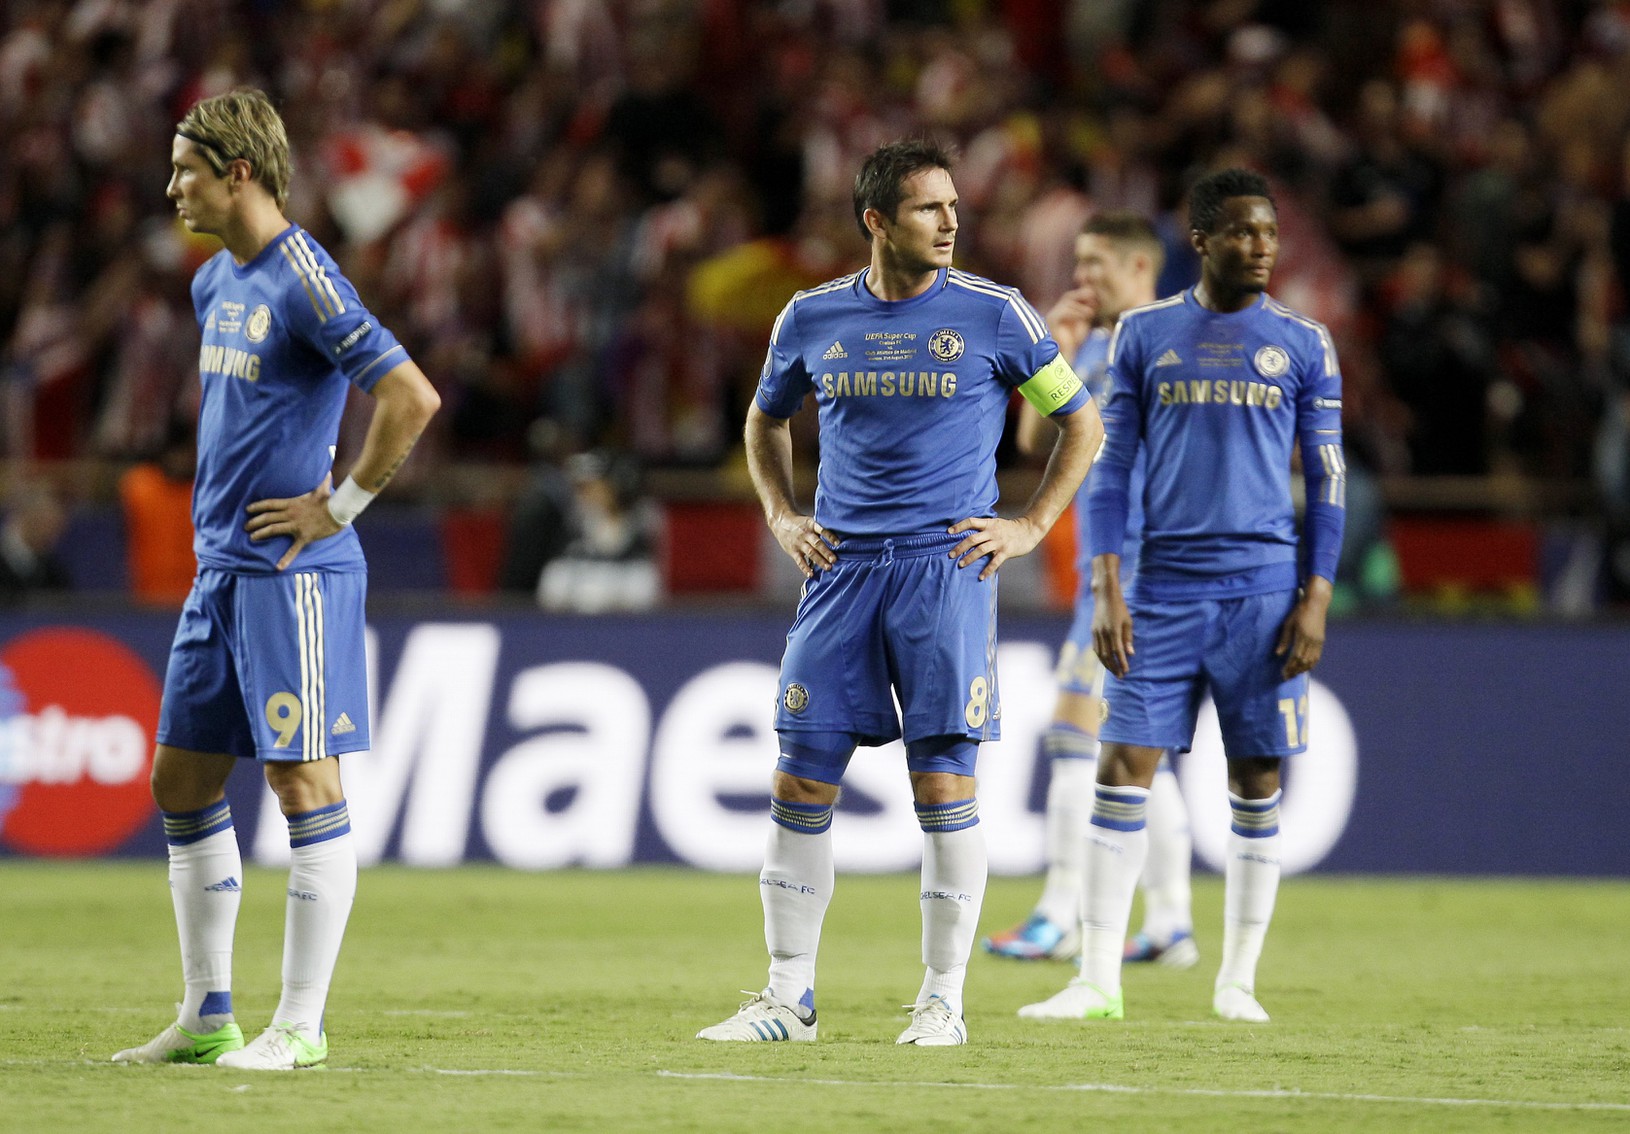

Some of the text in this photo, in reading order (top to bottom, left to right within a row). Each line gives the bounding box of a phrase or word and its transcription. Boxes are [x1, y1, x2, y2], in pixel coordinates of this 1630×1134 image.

[865, 333, 917, 341] UEFA Super Cup
[822, 352, 849, 361] adidas
[821, 371, 957, 398] SAMSUNG
[1158, 379, 1282, 410] SAMSUNG
[965, 675, 988, 729] 8
[265, 691, 302, 749] 9
[801, 885, 816, 895] FC
